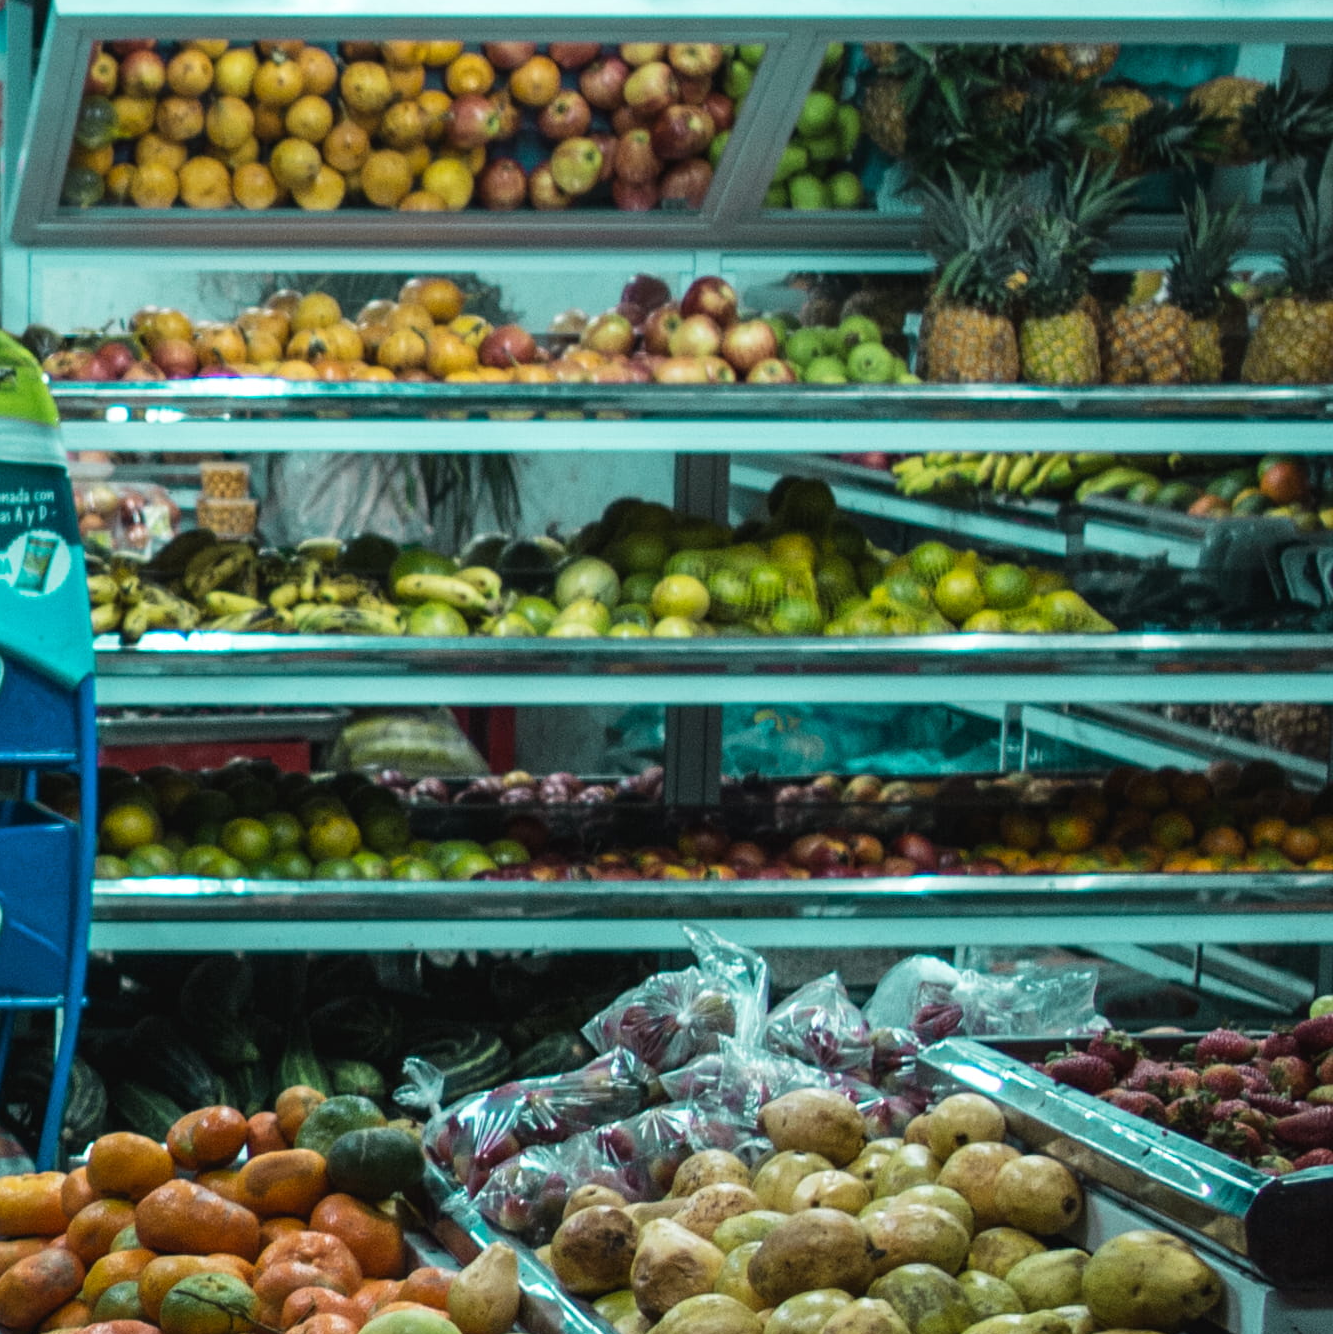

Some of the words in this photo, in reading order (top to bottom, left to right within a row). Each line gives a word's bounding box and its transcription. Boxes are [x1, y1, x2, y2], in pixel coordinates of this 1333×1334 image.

[34, 490, 55, 502] con
[15, 507, 23, 521] A
[26, 511, 35, 527] y
[39, 505, 47, 522] D
